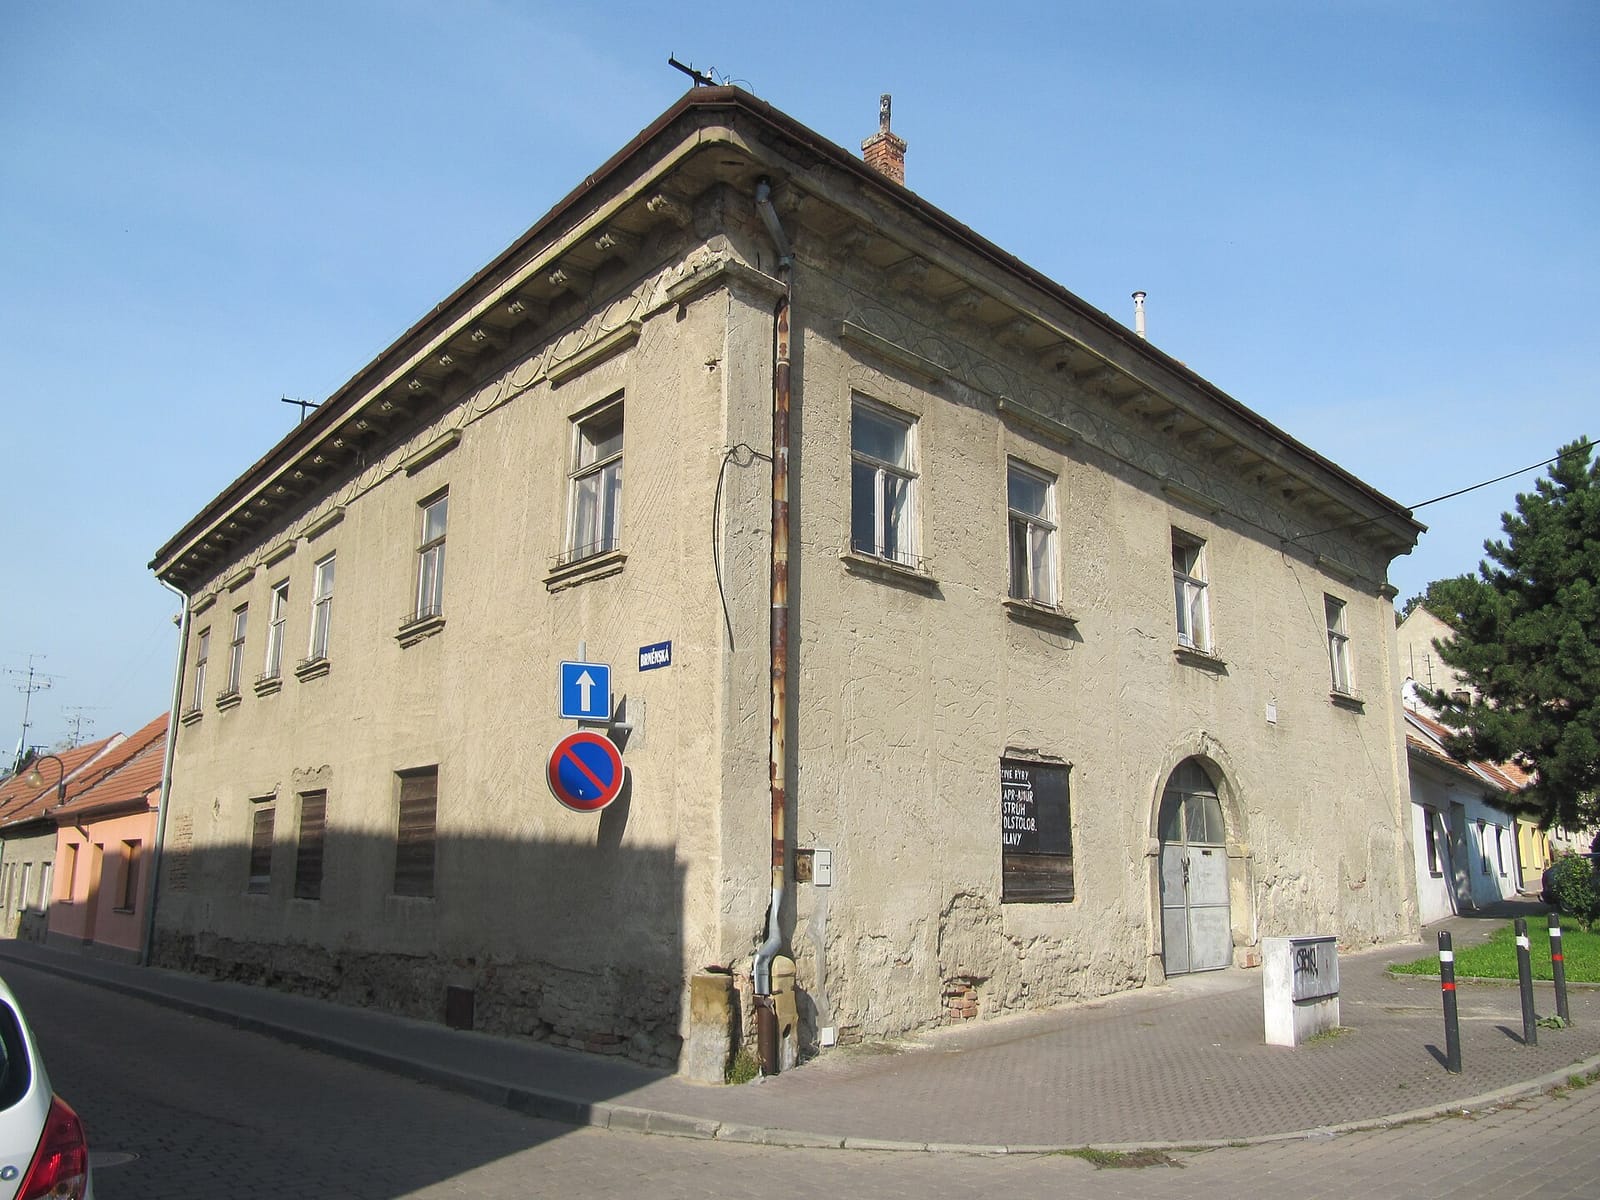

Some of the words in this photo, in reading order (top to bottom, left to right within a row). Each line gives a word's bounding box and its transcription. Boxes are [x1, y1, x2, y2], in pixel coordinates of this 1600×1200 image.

[1003, 789, 1034, 804] APR-AMUR
[1002, 801, 1026, 816] STRUH
[1003, 815, 1038, 832] OLSTOLOB.
